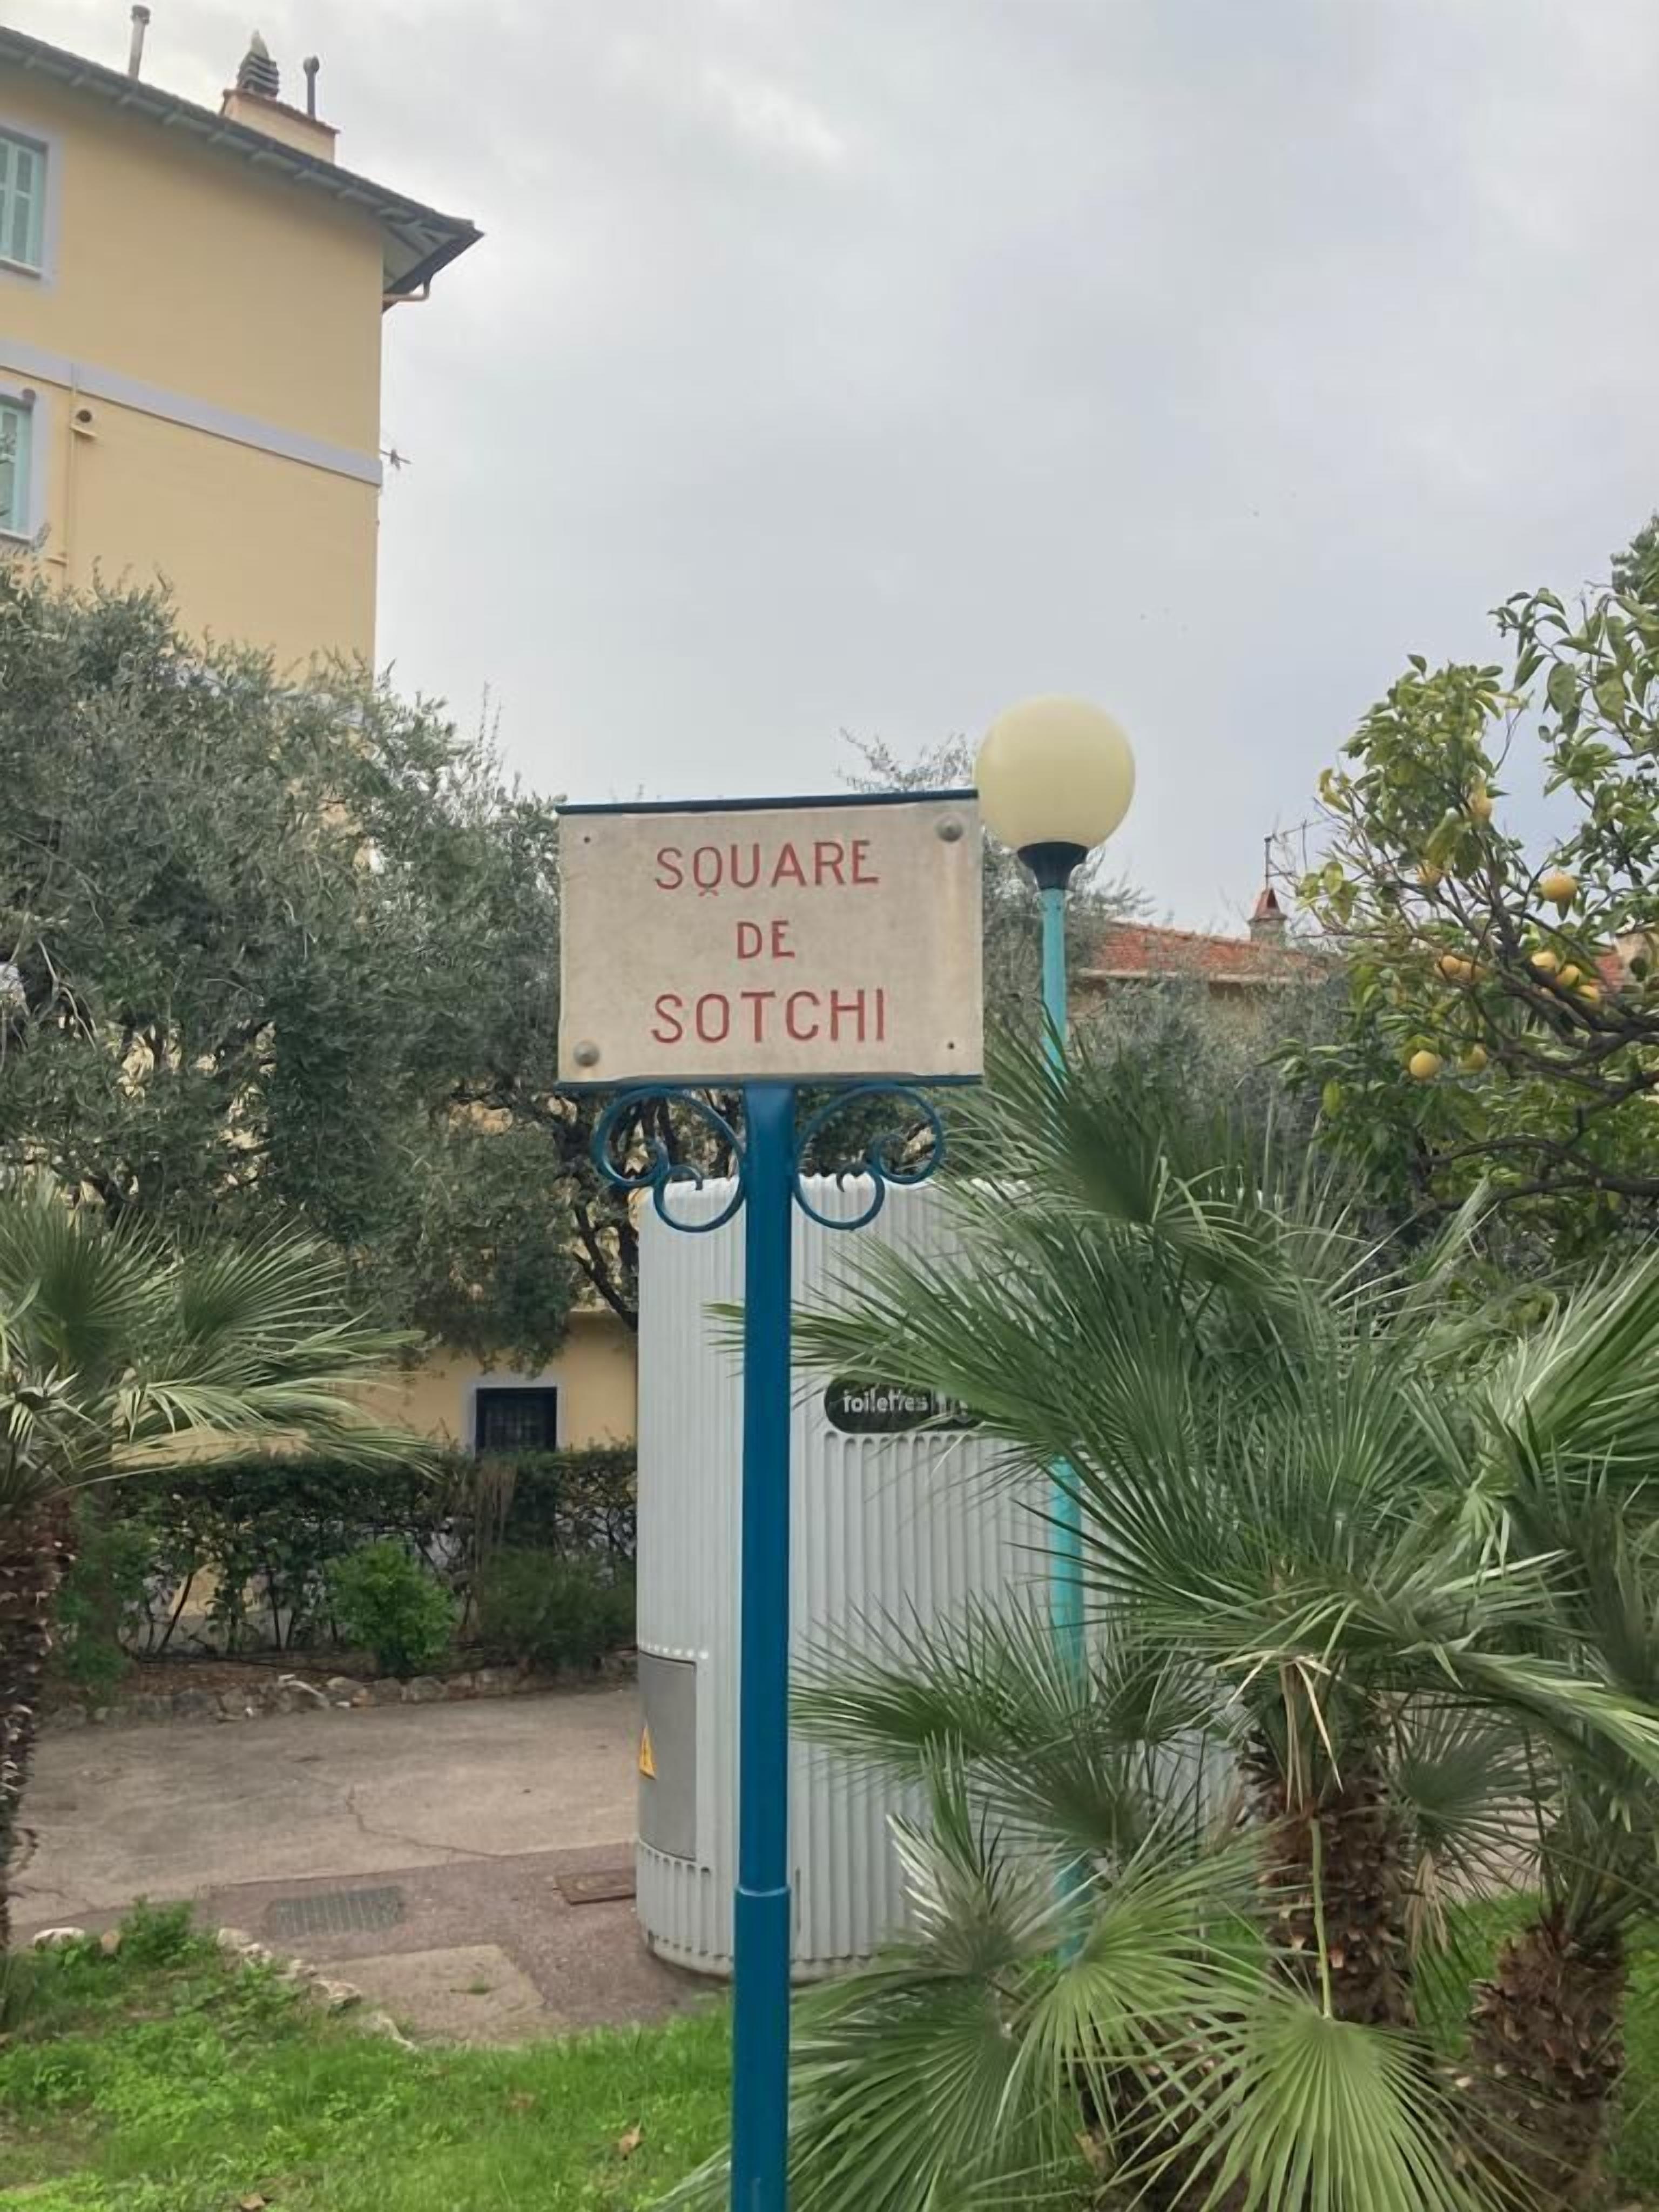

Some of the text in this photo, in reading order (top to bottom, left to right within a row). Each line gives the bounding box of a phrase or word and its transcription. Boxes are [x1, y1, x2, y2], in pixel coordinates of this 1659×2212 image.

[653, 839, 880, 897] SQUARE
[736, 920, 795, 960] DE
[651, 988, 886, 1044] SOTCHI
